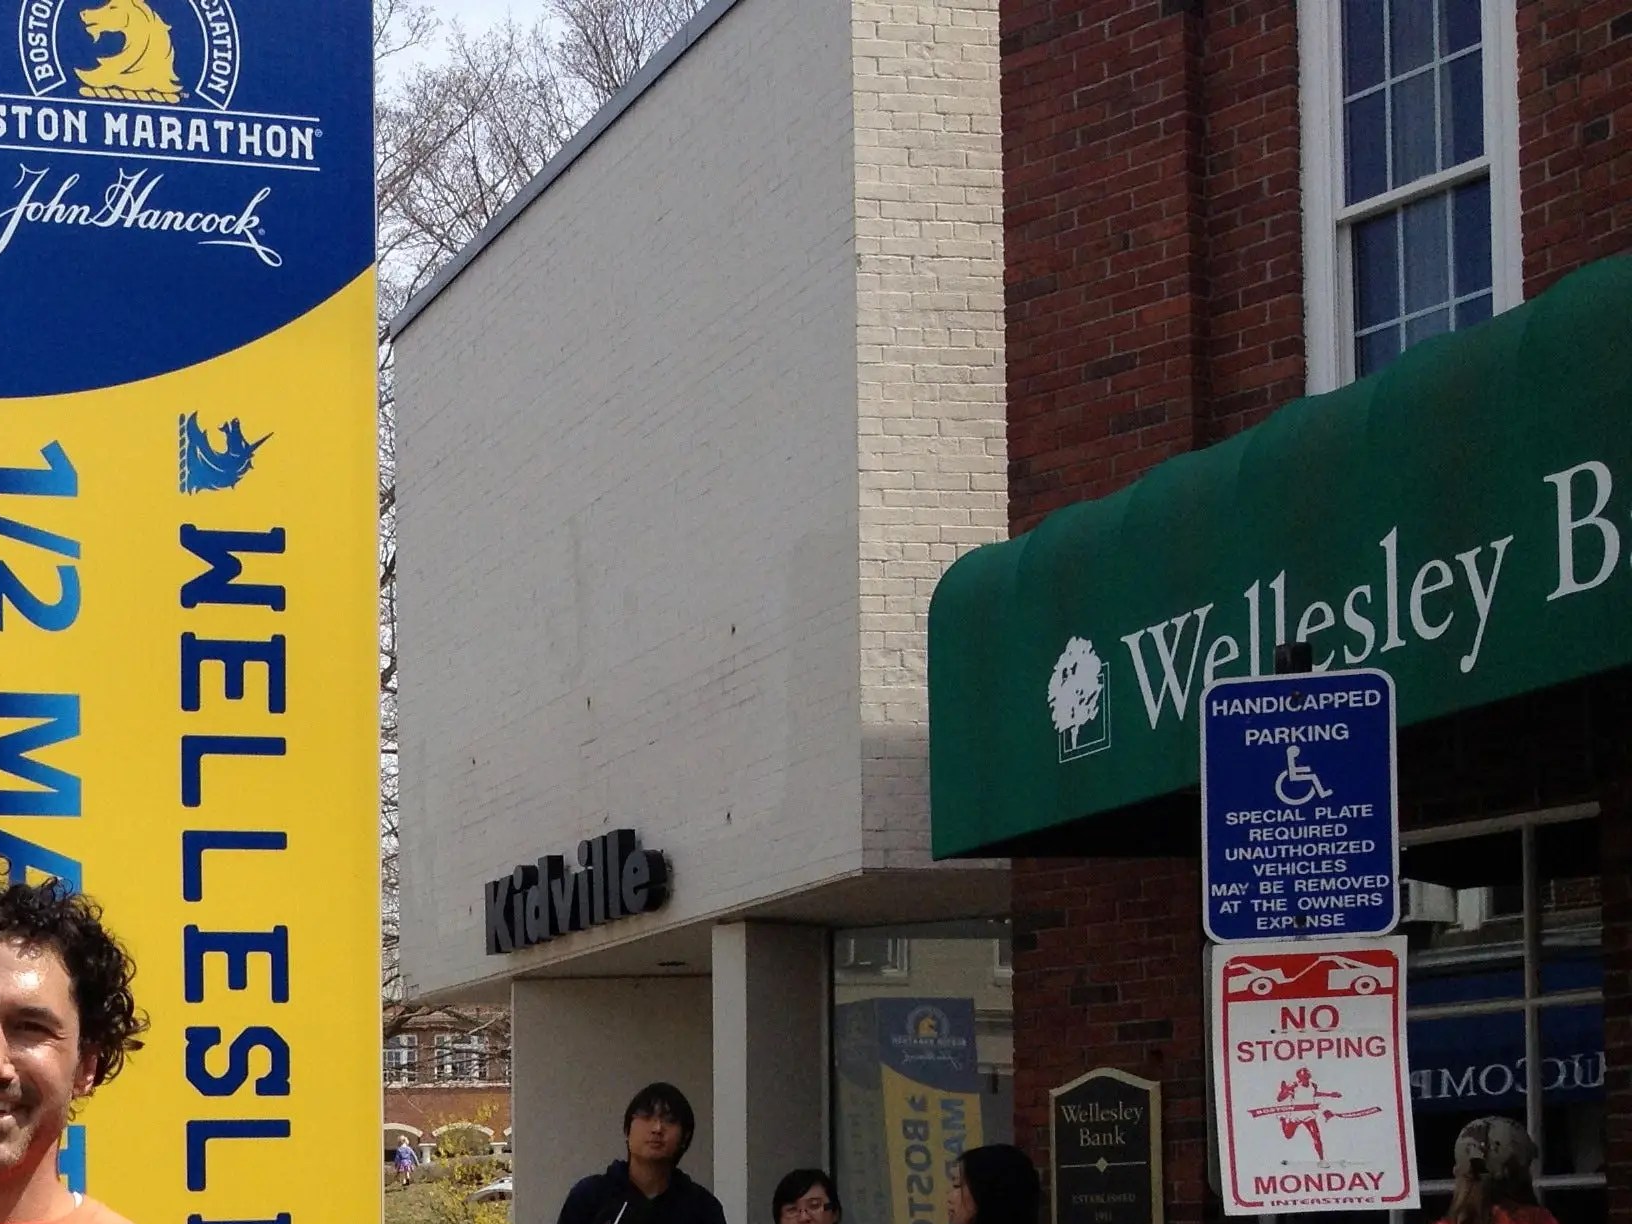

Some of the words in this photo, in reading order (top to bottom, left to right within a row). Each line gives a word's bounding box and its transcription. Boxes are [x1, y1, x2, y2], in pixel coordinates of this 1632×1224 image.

[27, 0, 55, 82] BOSTO
[199, 0, 233, 95] CIATION
[103, 111, 317, 161] MARATHON
[89, 167, 283, 269] Hancock
[1119, 525, 1514, 731] Wellesley
[1543, 459, 1632, 602] B
[1211, 688, 1382, 717] HANDICAPPED
[1244, 722, 1349, 746] PARKING
[1225, 808, 1306, 826] SPECIAL
[1314, 804, 1374, 820] PLATE
[1249, 823, 1348, 842] REQUIRED
[1225, 839, 1376, 861] UNAUTHORIZED
[1252, 859, 1348, 877] VEHICLES
[484, 828, 668, 956] Kidville
[1211, 882, 1249, 897] MAY
[1259, 880, 1285, 894] BE
[1294, 874, 1390, 893] REMOVED
[1219, 900, 1242, 914] AT
[1250, 898, 1288, 913] THE
[1297, 892, 1384, 911] OWNERS
[1280, 1004, 1340, 1033] NO
[1237, 1035, 1387, 1063] STOPPING
[1060, 1100, 1144, 1126] Wellesley
[1079, 1125, 1126, 1147] Bank
[1254, 1171, 1385, 1195] MONDAY
[1270, 1196, 1377, 1207] INTERSTATE
